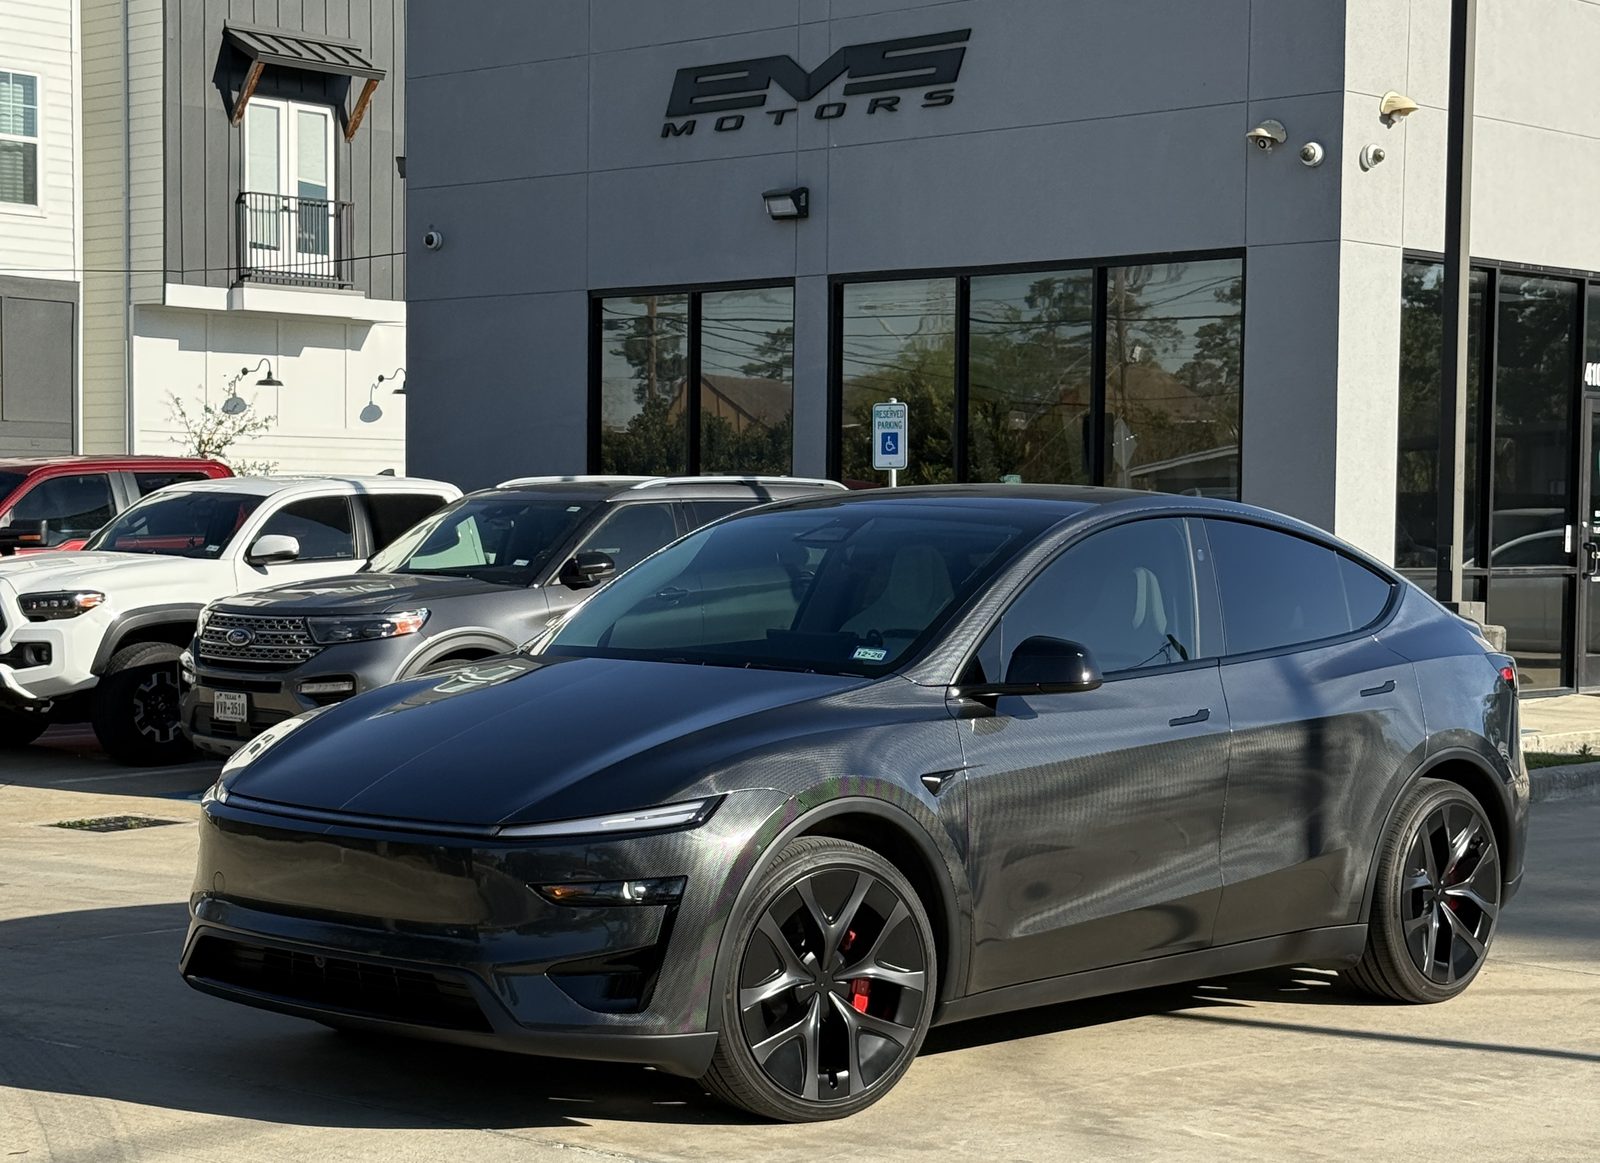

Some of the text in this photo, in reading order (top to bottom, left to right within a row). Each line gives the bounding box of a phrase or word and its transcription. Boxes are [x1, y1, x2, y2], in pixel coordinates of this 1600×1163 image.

[661, 88, 955, 139] MOTORS
[875, 409, 904, 419] RESERVED
[877, 420, 903, 430] PARKING
